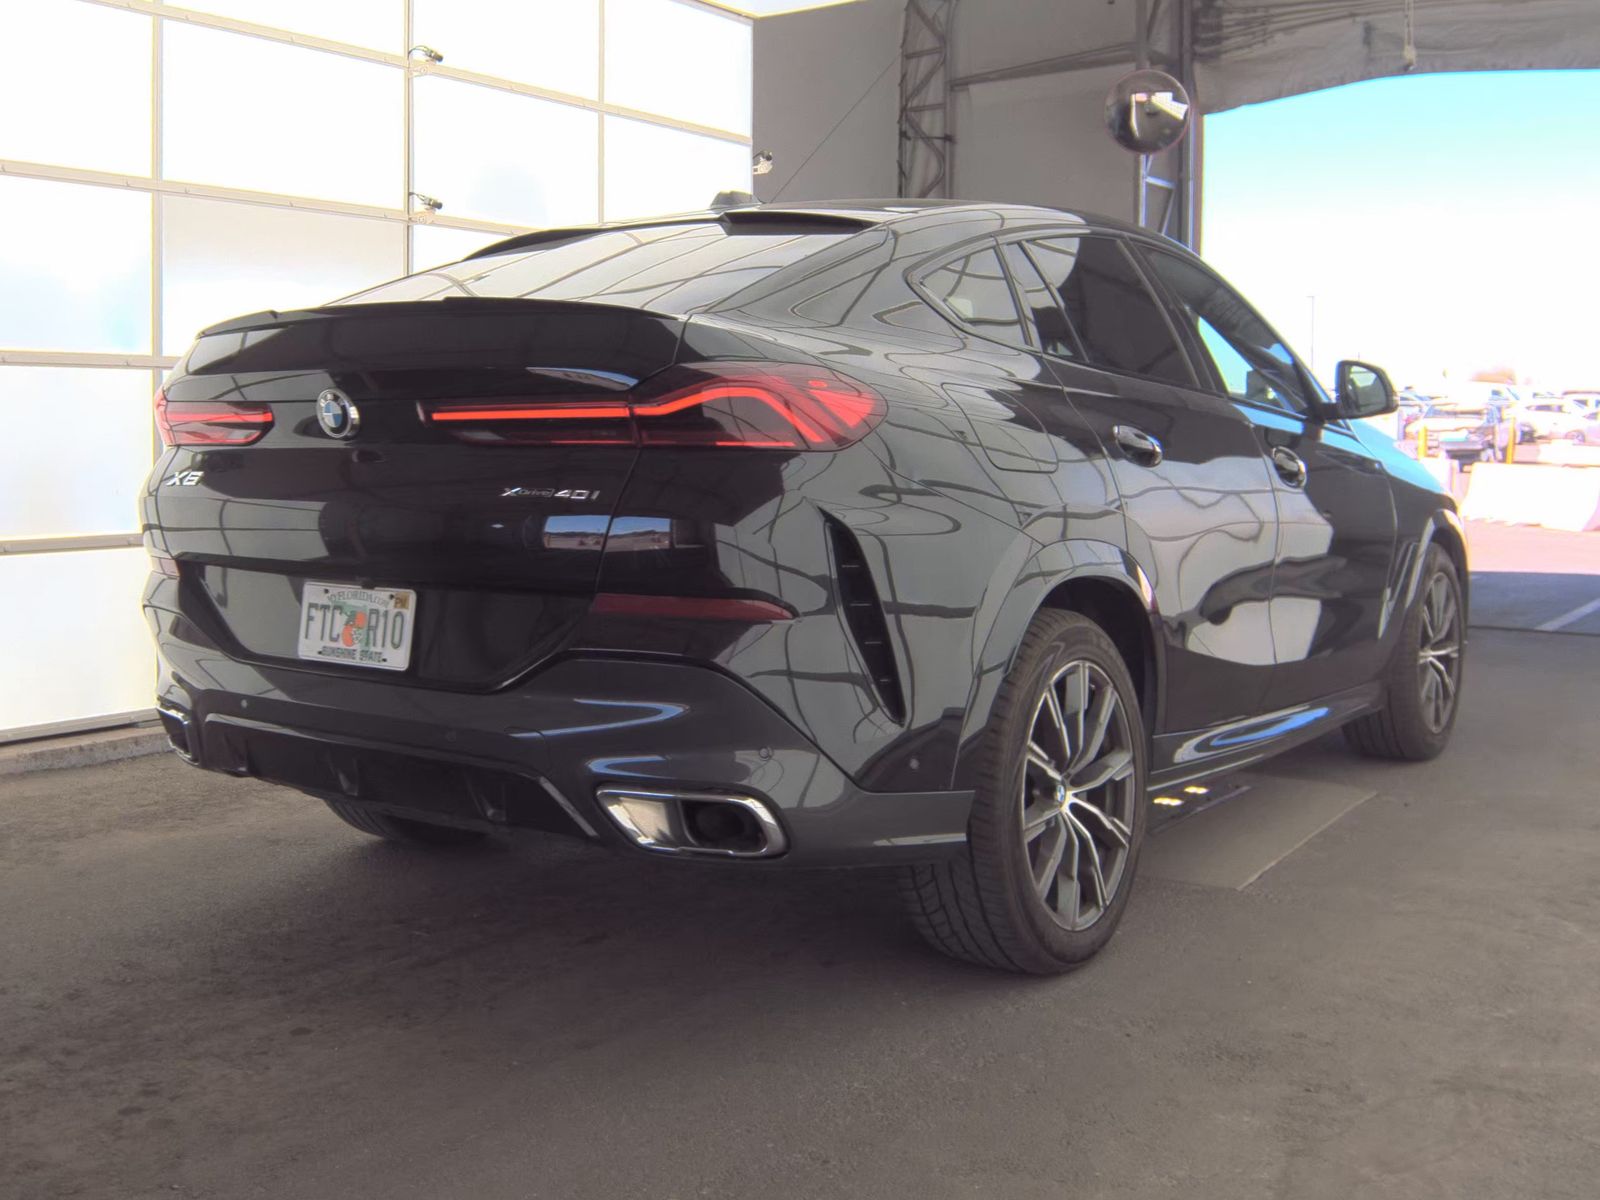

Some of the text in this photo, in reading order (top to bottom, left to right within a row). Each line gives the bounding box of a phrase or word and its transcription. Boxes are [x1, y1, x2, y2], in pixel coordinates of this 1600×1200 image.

[165, 471, 204, 486] X6
[305, 602, 405, 650] FTC R10
